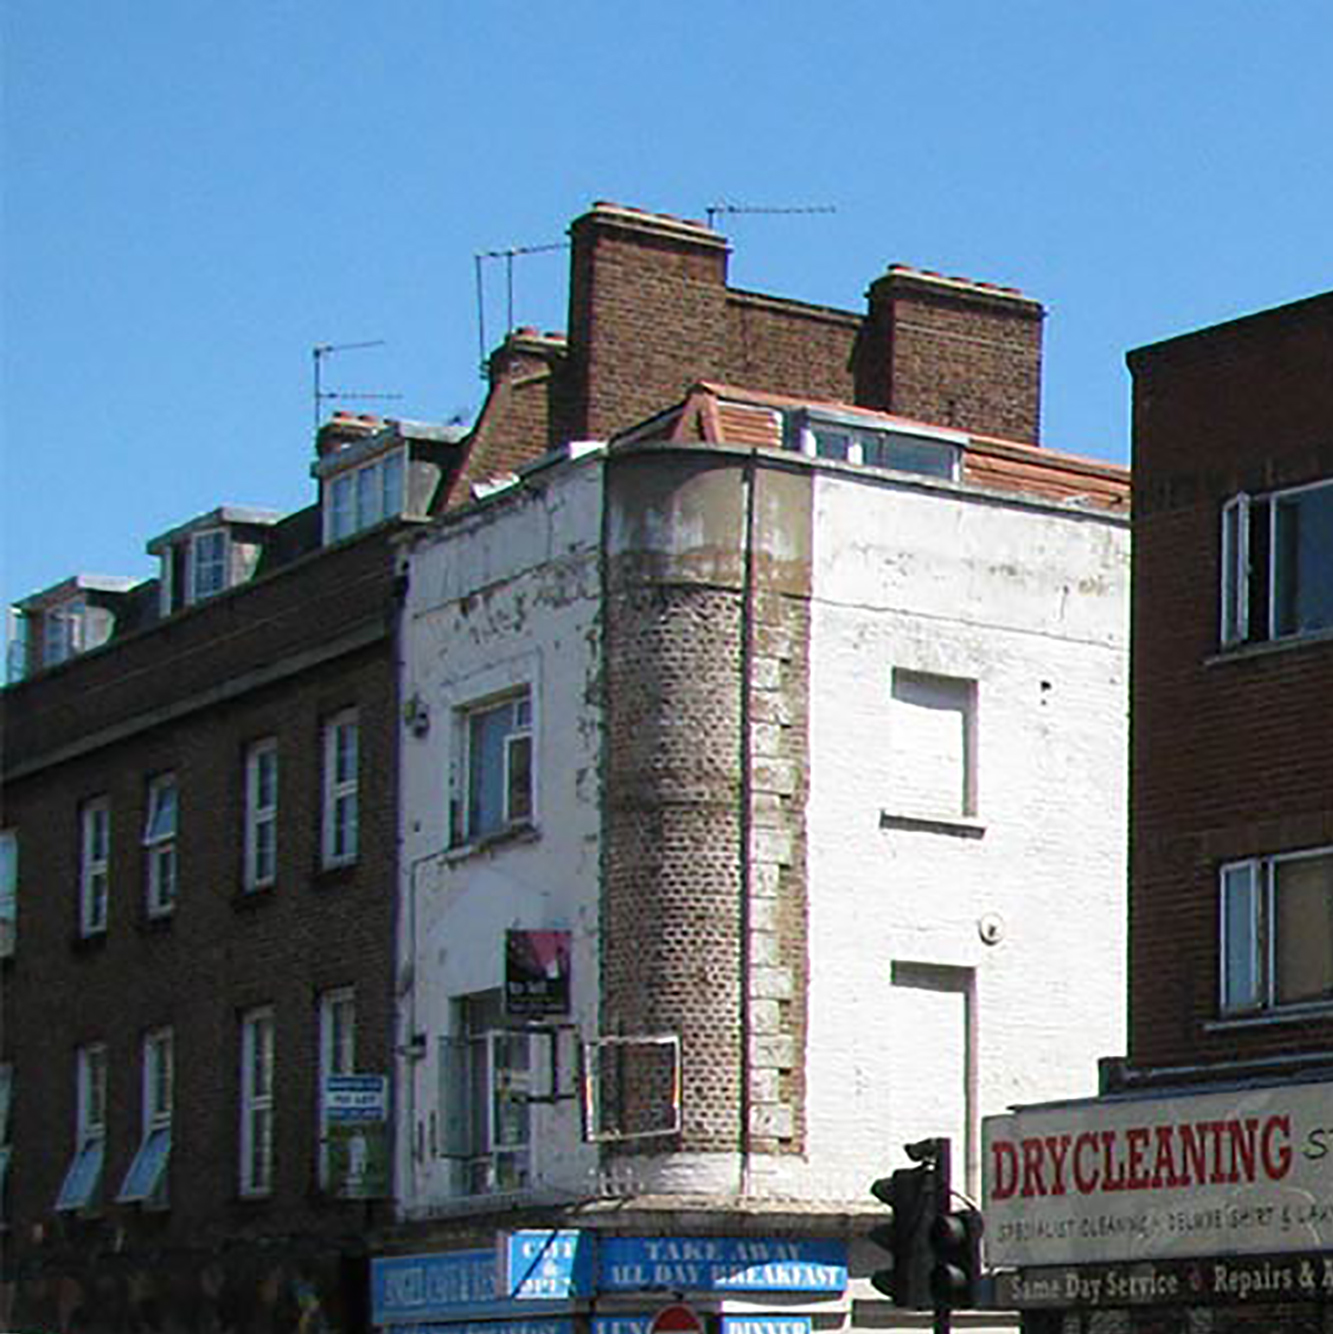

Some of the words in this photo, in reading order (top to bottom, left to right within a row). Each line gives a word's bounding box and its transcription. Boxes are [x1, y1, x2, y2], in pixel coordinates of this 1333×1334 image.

[991, 1115, 1291, 1201] DRYCLEANING
[645, 1241, 724, 1261] TAKE
[731, 1240, 802, 1261] AWAY
[611, 1265, 649, 1285] ALL
[654, 1264, 701, 1284] DAY
[711, 1263, 838, 1286] BREAKFAST
[1011, 1274, 1062, 1301] Same
[1065, 1269, 1101, 1305] Day
[1106, 1268, 1178, 1298] Service
[1213, 1262, 1292, 1299] Repairs
[1299, 1259, 1316, 1290] &
